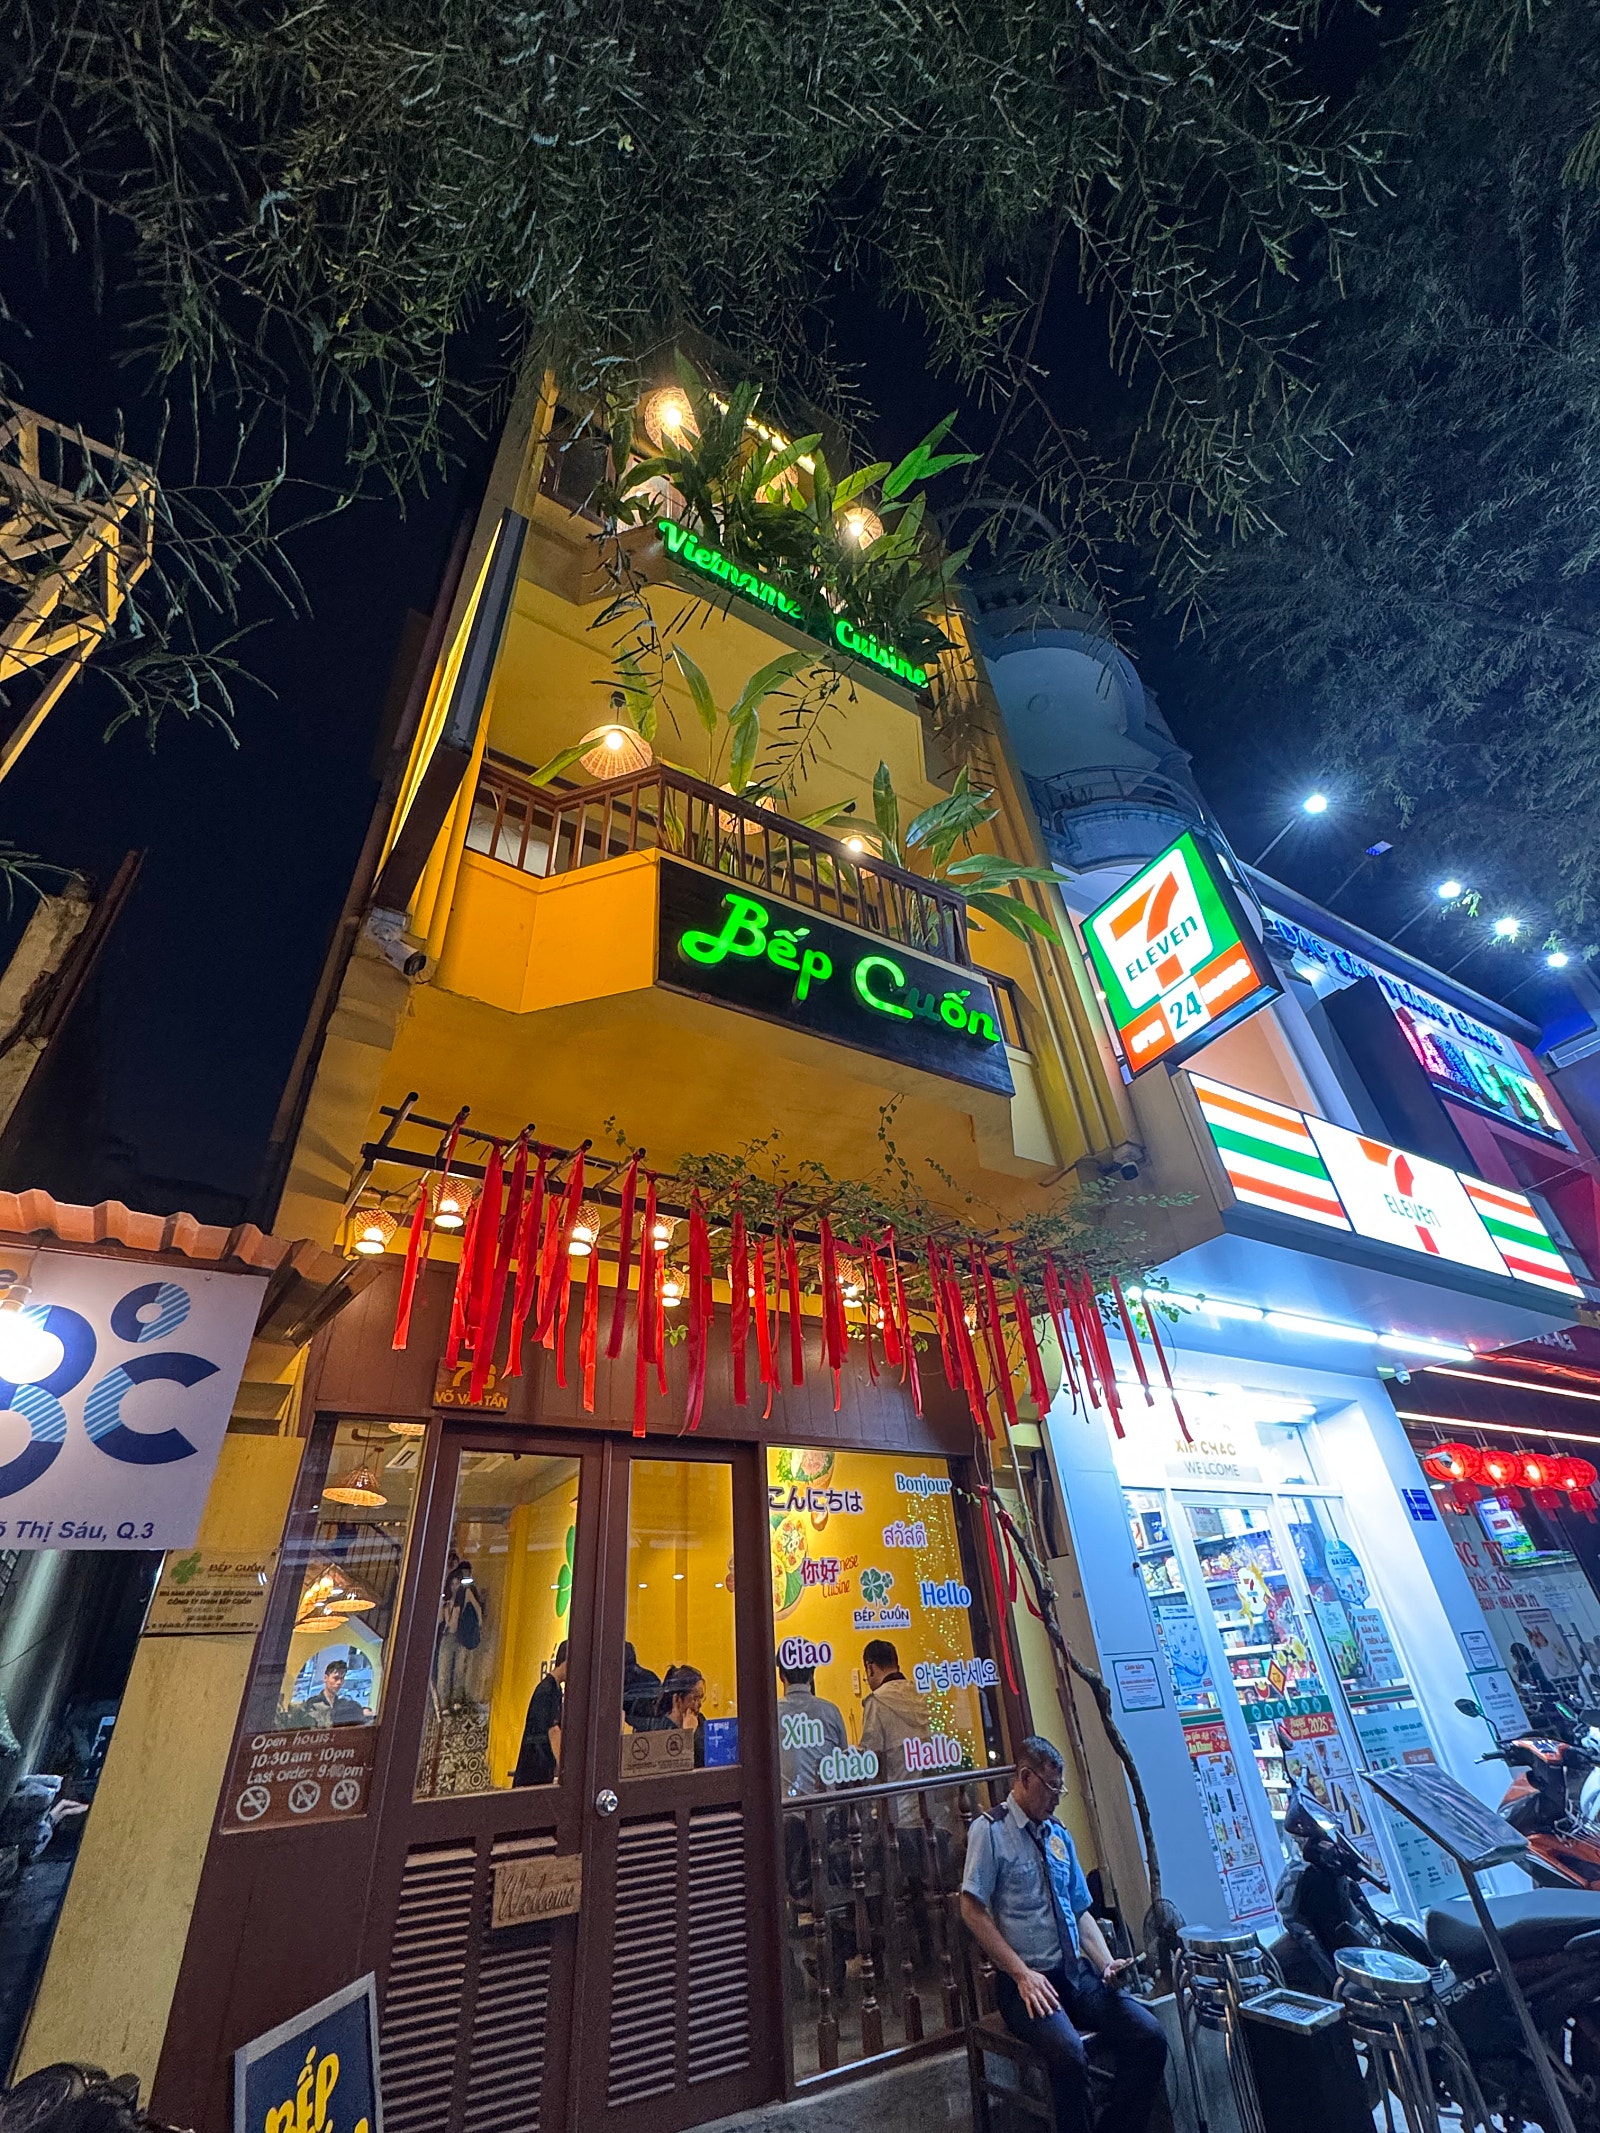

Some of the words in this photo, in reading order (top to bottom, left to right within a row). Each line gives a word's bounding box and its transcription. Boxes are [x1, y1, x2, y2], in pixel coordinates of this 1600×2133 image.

[658, 519, 804, 620] Vietname
[836, 620, 930, 689] Cuisine
[680, 893, 833, 1001] Bếp
[855, 955, 1001, 1043] Cuốn
[1170, 991, 1202, 1029] 24
[435, 1389, 455, 1403] VÕ
[1183, 1461, 1241, 1477] WELCOME
[896, 1473, 952, 1498] Bonjour
[768, 1487, 863, 1512] こんにちは
[16, 1520, 53, 1543] Thị
[62, 1521, 108, 1541] Sáu,
[116, 1522, 154, 1540] Q.3
[884, 1522, 927, 1548] สวัสดี
[801, 1558, 839, 1584] 你好
[921, 1582, 971, 1607] Hello
[854, 1606, 875, 1621] BẾP
[880, 1605, 909, 1620] CUỐN
[780, 1639, 831, 1666] Ciao
[915, 1660, 999, 1691] 안녕하세요
[783, 1716, 822, 1747] Xin
[1308, 1717, 1329, 1735] 2025
[251, 1735, 286, 1752] Open
[292, 1732, 336, 1745] hours:
[904, 1737, 961, 1769] Hallo
[247, 1769, 274, 1784] Last
[276, 1767, 313, 1781] order:
[821, 1749, 877, 1780] chào
[498, 1868, 575, 1921] Welcome
